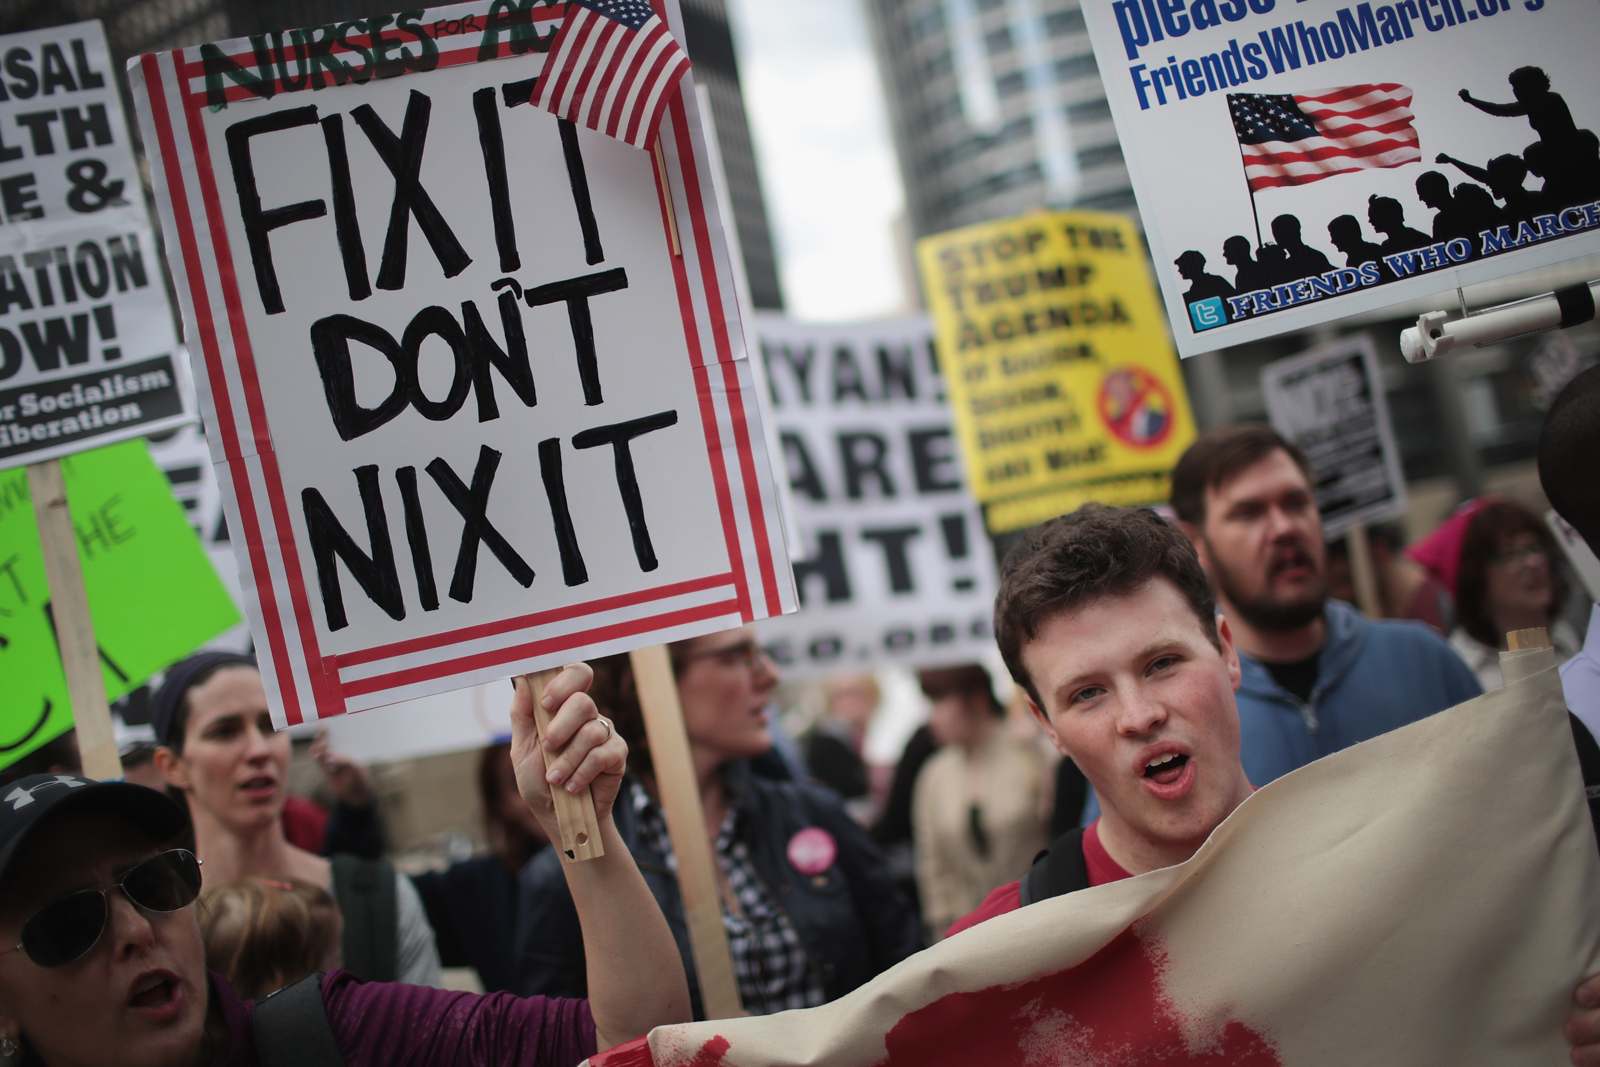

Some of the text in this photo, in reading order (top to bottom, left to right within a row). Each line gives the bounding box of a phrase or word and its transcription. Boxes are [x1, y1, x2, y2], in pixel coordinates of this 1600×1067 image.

[0, 38, 105, 101] SAL
[199, 0, 569, 113] NURSES FOR AC
[1130, 0, 1545, 110] FriendsWhoMarch.
[65, 158, 131, 214] &
[225, 76, 605, 315] FIX IT
[939, 228, 1047, 274] STOP
[1227, 260, 1381, 321] FRIENDS
[1382, 236, 1473, 281] WHO
[949, 264, 1096, 311] TRUMP
[310, 267, 629, 441] DON'T
[958, 300, 1134, 350] AGENDA
[0, 401, 143, 449] iberation
[18, 369, 172, 418] Socialism
[779, 427, 963, 501] ARE
[301, 444, 536, 632] NIX
[538, 410, 678, 588] IT
